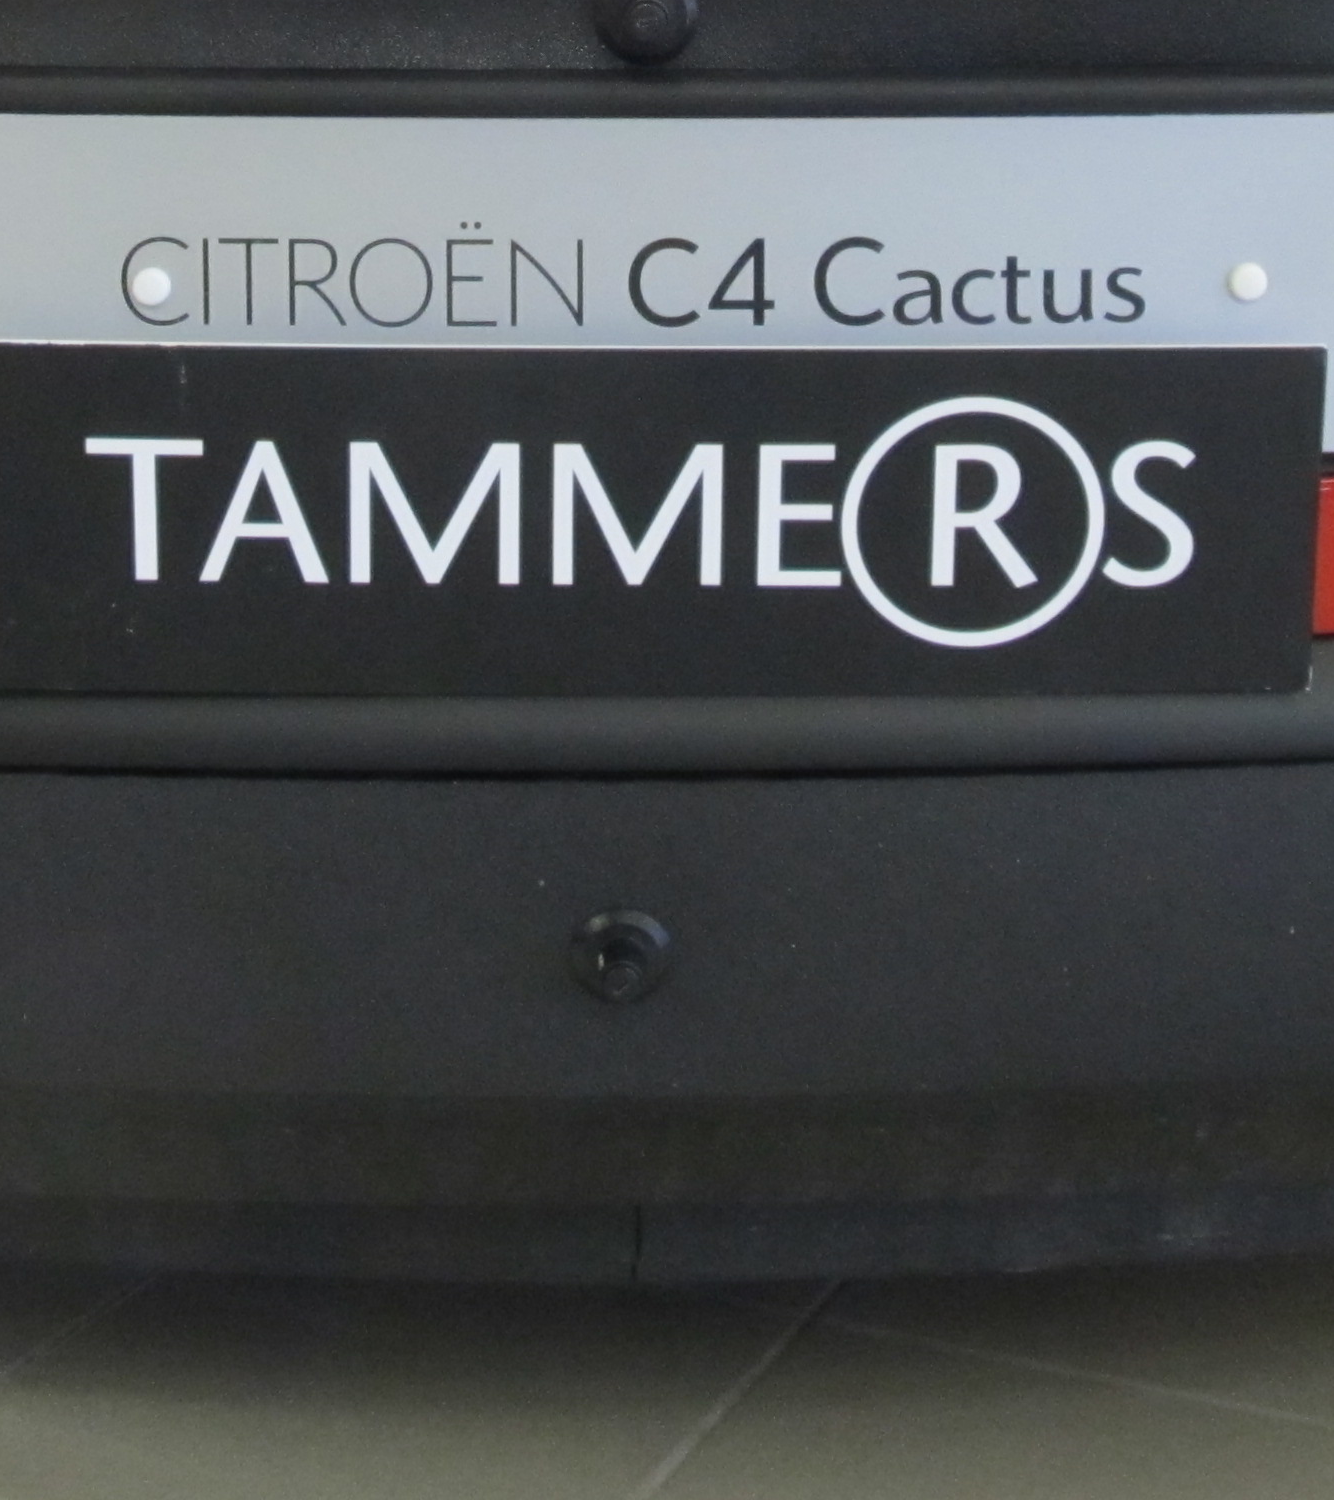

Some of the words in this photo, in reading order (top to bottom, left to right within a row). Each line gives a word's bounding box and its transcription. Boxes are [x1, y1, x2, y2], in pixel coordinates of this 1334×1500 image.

[120, 219, 585, 328] CITROËN
[627, 236, 776, 328] C4
[812, 236, 1147, 328] Cactus
[83, 394, 1197, 649] TAMMERS
